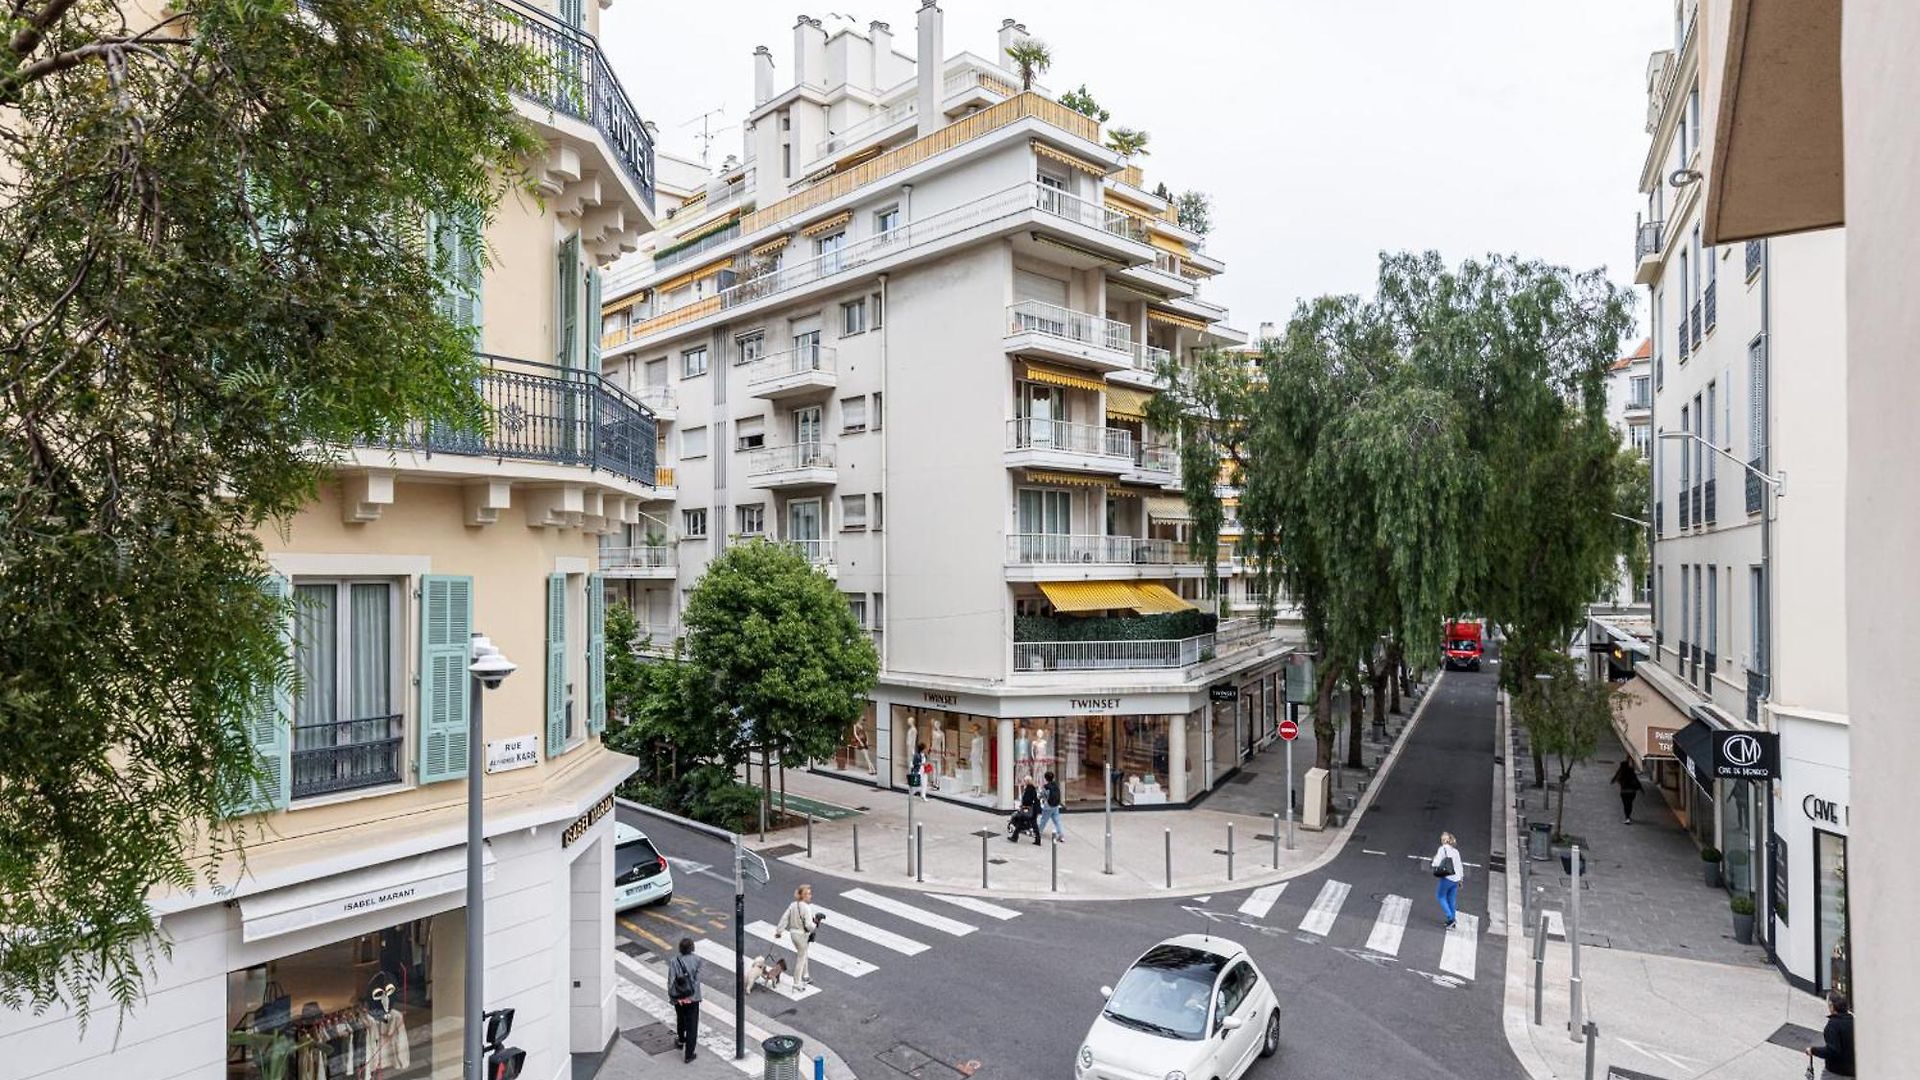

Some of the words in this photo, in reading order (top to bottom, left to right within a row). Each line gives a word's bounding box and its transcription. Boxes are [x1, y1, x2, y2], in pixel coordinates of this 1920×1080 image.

[612, 93, 651, 187] HOTEL
[923, 691, 958, 705] TWINSET
[1070, 698, 1121, 709] TWINSET
[505, 741, 522, 751] RUE
[516, 750, 536, 761] KARR
[1802, 794, 1838, 825] CAVE
[565, 815, 590, 847] ISABEL
[590, 795, 613, 825] MARAN
[344, 899, 375, 911] ISABEL
[379, 889, 415, 902] MARANT
